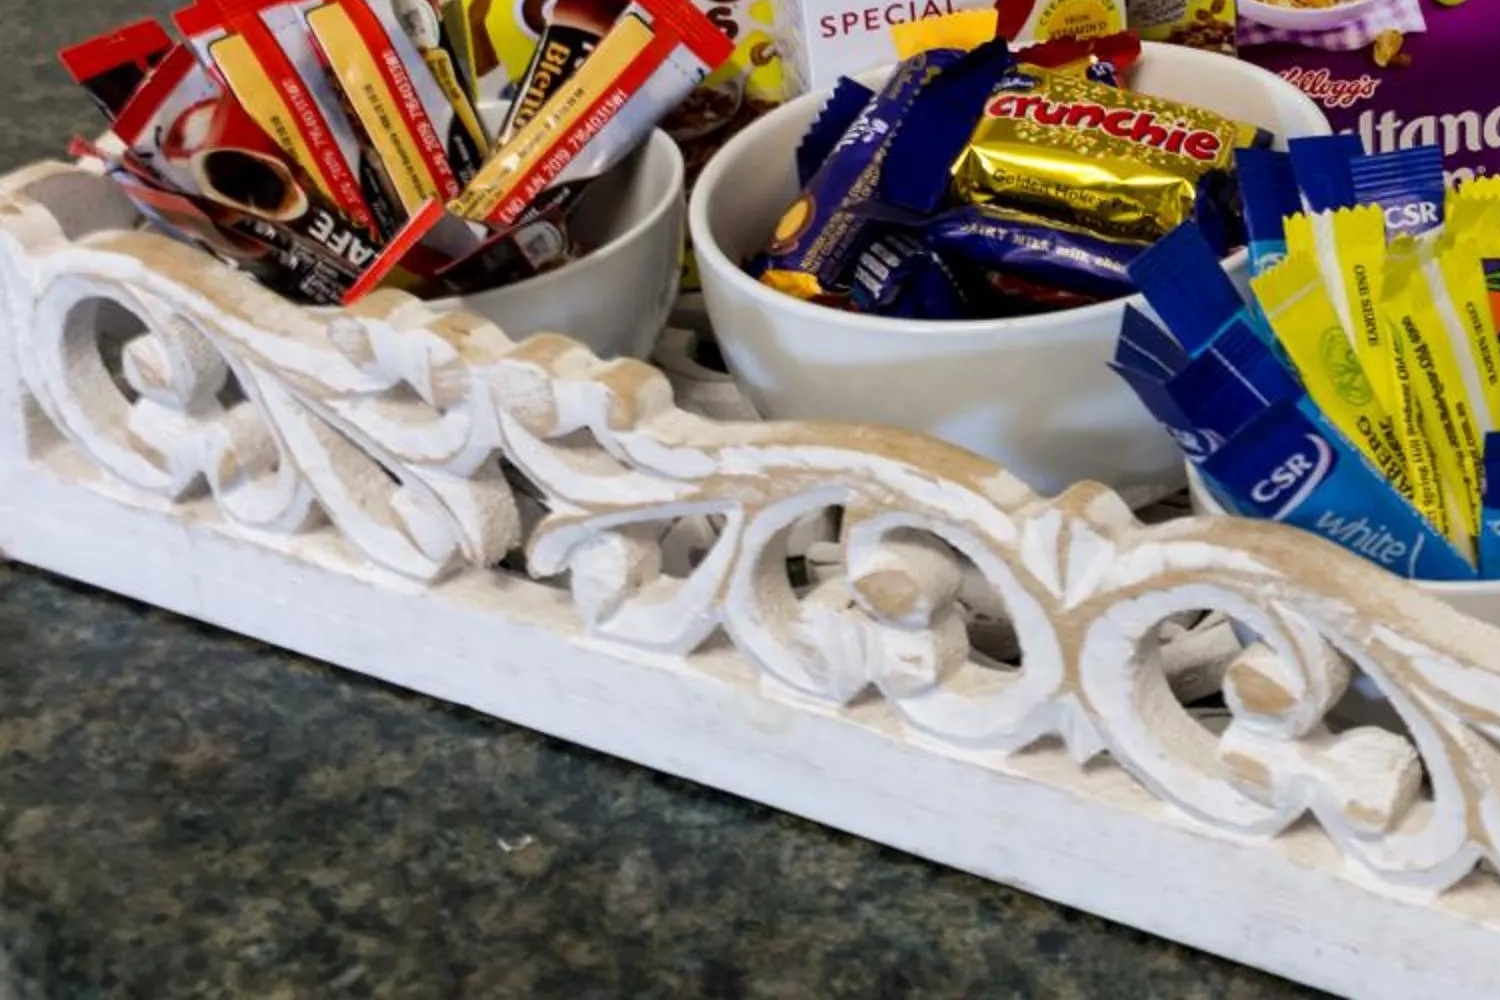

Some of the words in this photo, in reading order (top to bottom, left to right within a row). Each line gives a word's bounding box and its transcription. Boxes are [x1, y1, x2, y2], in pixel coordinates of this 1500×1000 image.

[991, 167, 1049, 196] Golden
[1384, 200, 1441, 229] CSR
[1250, 451, 1313, 504] CSR
[1315, 508, 1409, 566] white
